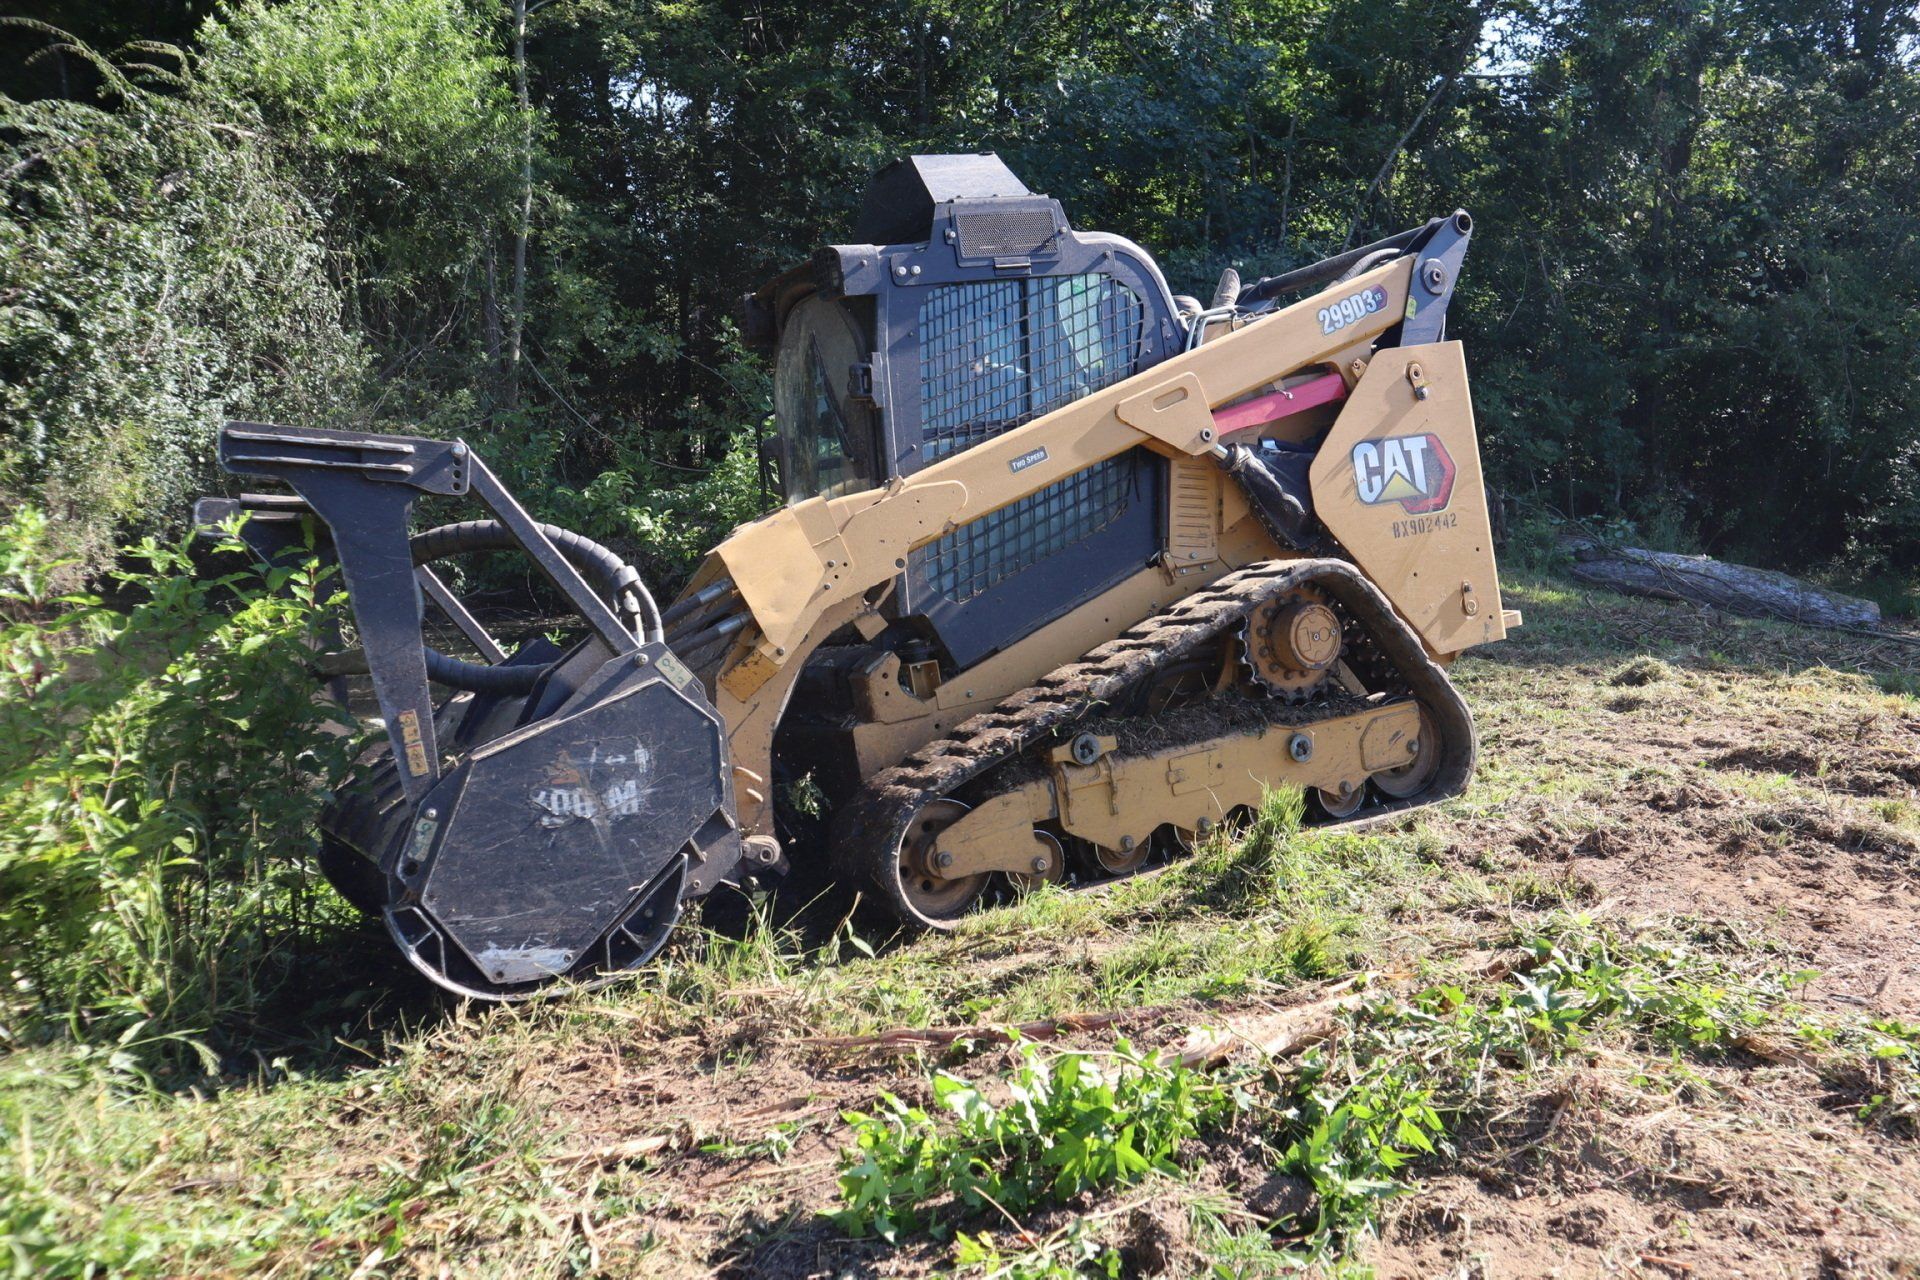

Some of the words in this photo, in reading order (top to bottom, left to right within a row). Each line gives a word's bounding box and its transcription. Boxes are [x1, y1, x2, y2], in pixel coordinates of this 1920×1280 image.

[1318, 289, 1377, 334] 299D3
[1012, 459, 1026, 470] TWO
[1353, 435, 1429, 504] CAT
[1392, 512, 1458, 539] BX902442
